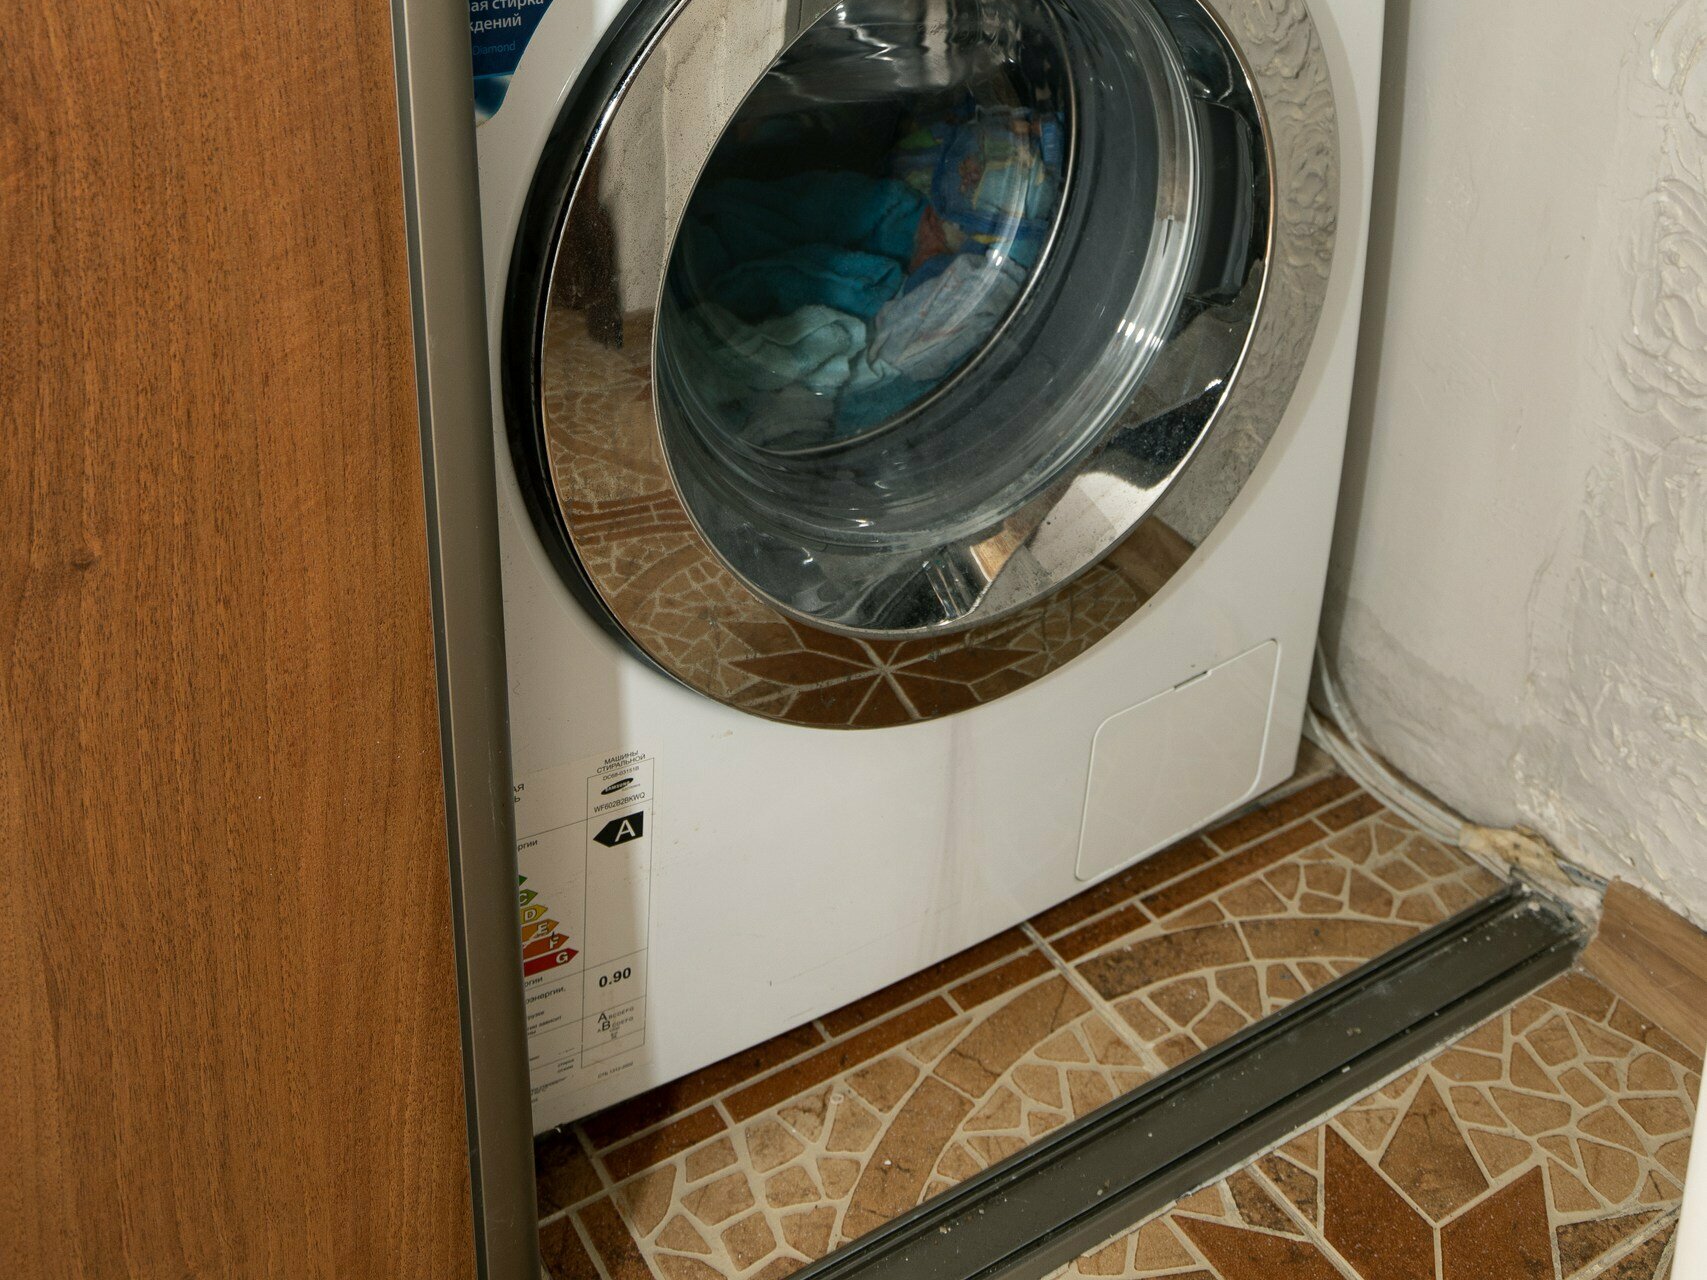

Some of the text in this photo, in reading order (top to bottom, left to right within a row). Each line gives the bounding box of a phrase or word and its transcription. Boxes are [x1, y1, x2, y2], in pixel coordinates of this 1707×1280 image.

[596, 753, 646, 774] СТИРАЛЬНОЙ
[604, 749, 639, 765] МАШИНЫ
[614, 819, 636, 842] A
[524, 909, 537, 923] D
[537, 922, 549, 936] E
[549, 934, 559, 950] F
[556, 951, 569, 963] G
[598, 967, 632, 988] 0.90
